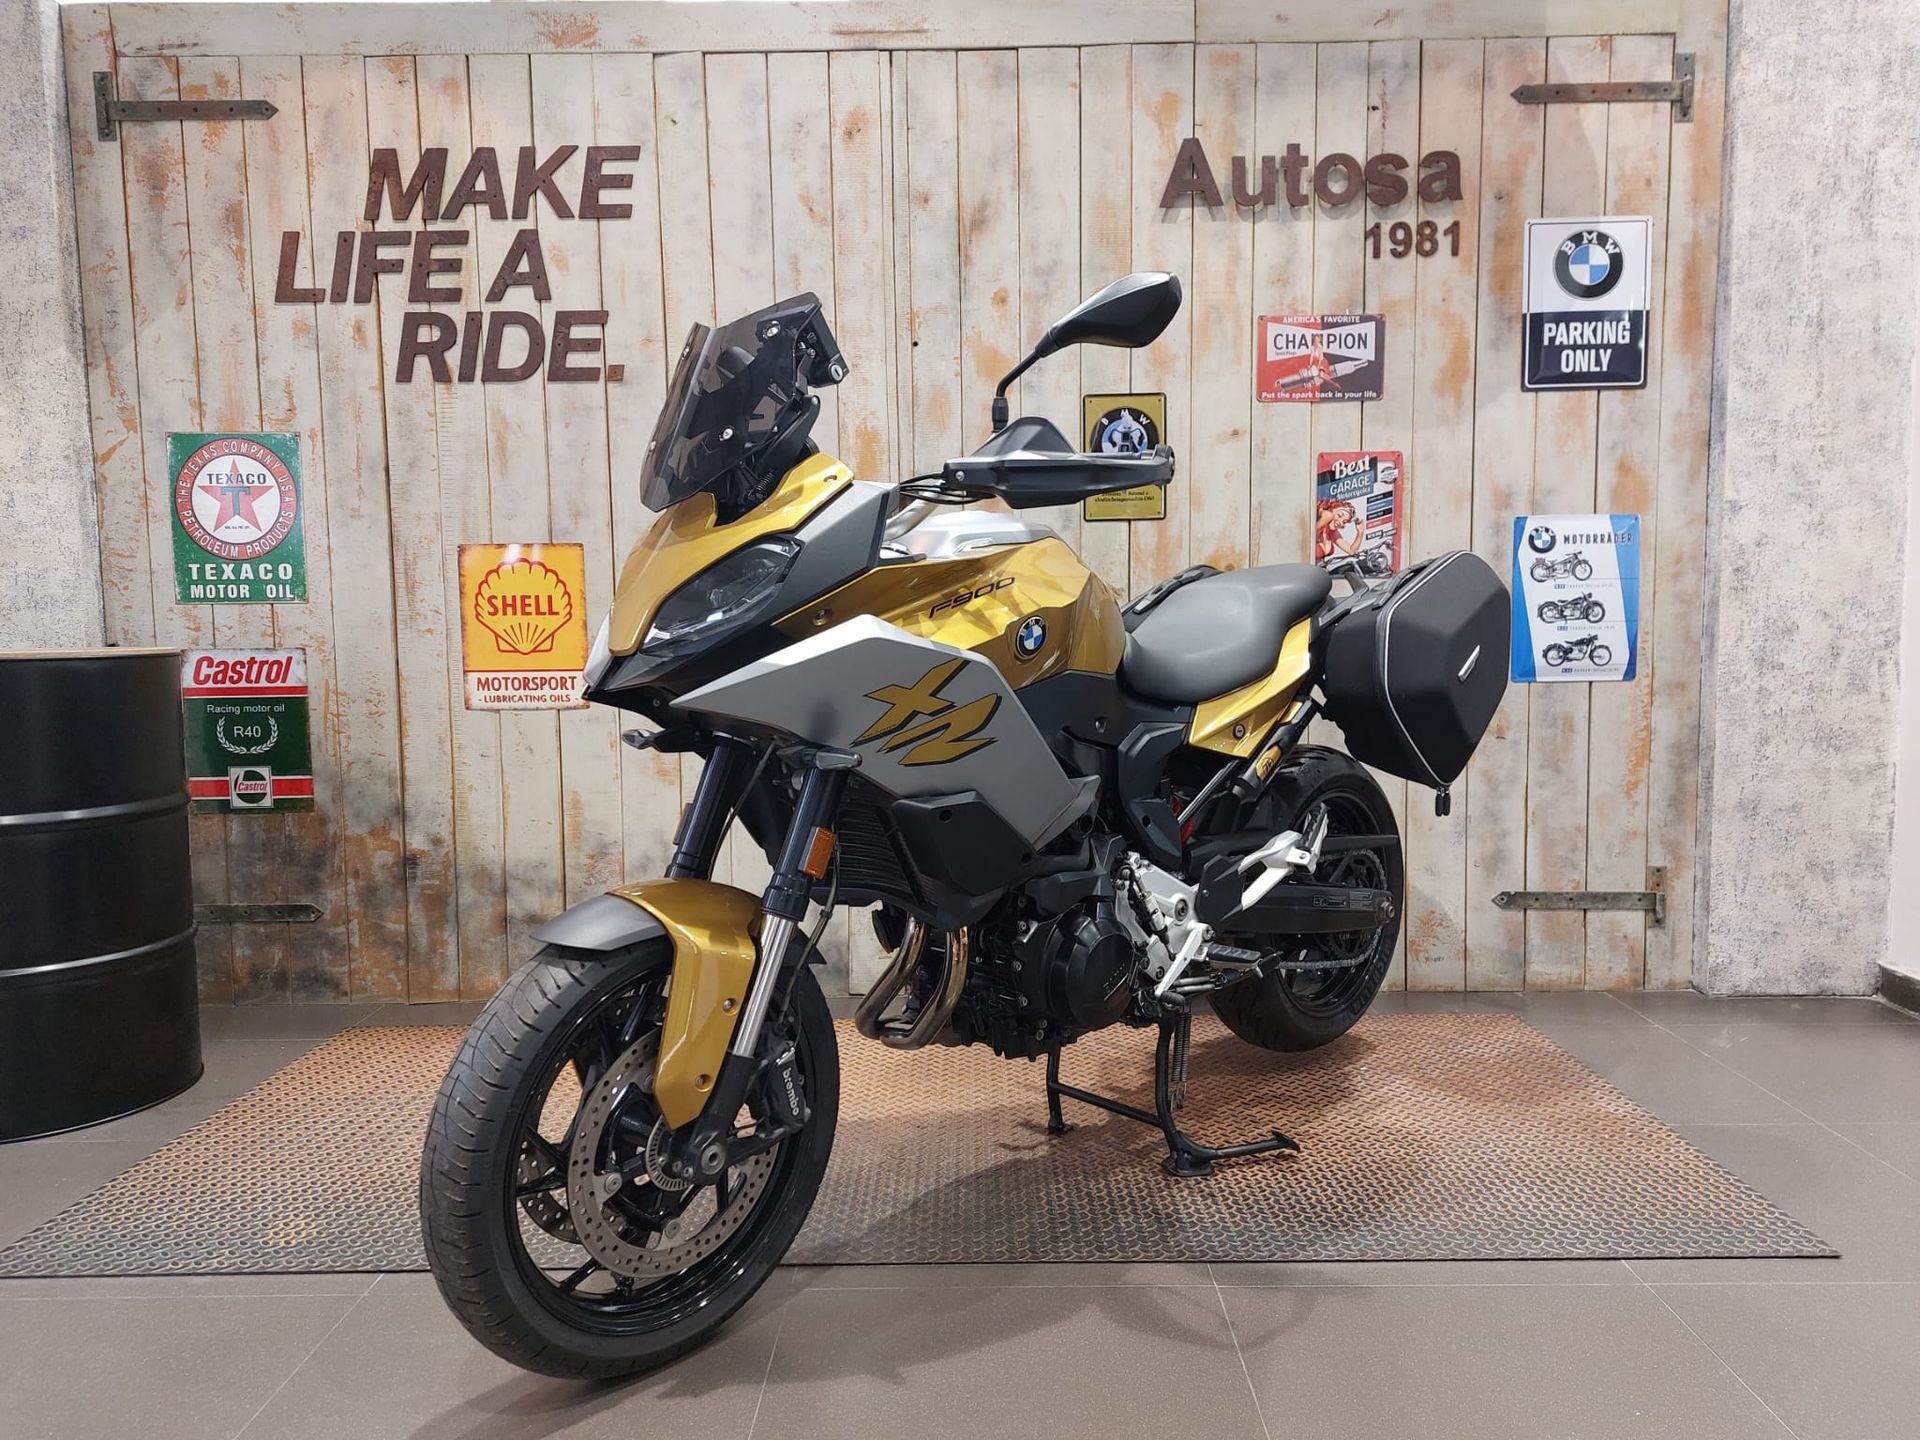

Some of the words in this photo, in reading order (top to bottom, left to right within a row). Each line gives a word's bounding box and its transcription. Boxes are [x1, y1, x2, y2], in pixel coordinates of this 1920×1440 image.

[364, 144, 641, 221] MAKE
[1159, 138, 1464, 208] Autosa
[1365, 219, 1461, 259] 1981
[1561, 231, 1620, 256] BMW
[274, 230, 470, 303] LIFE
[484, 228, 552, 302] A
[1283, 316, 1321, 324] AMERICA'S
[1324, 315, 1360, 323] FAVORITE
[1543, 320, 1631, 346] PARKING
[396, 310, 625, 383] RIDE.
[1561, 348, 1612, 374] ONLY
[1292, 391, 1313, 399] spark
[1364, 390, 1377, 398] life
[184, 445, 218, 477] TEXAS
[222, 441, 281, 469] COMPANY
[1332, 454, 1370, 480] Best
[207, 473, 267, 485] TEXACO
[1330, 475, 1371, 496] GARAGE
[178, 481, 191, 503] THE
[180, 509, 239, 557] PETROLEUM
[246, 510, 294, 556] PRODUCTS
[188, 563, 293, 580] TEXACO
[190, 584, 250, 599] MOTOR
[266, 584, 294, 599] OIL
[929, 577, 1015, 619] F900
[487, 595, 560, 617] SHELL
[193, 655, 293, 686] Castrol
[476, 676, 577, 691] MOTORSPORT
[206, 704, 241, 715] Racing
[243, 704, 271, 713] motor
[273, 703, 285, 712] oil
[484, 694, 547, 703] LUBRICATING
[549, 694, 571, 703] OILS
[233, 725, 261, 738] R40
[237, 781, 268, 792] Castrol
[782, 1067, 800, 1116] brembo
